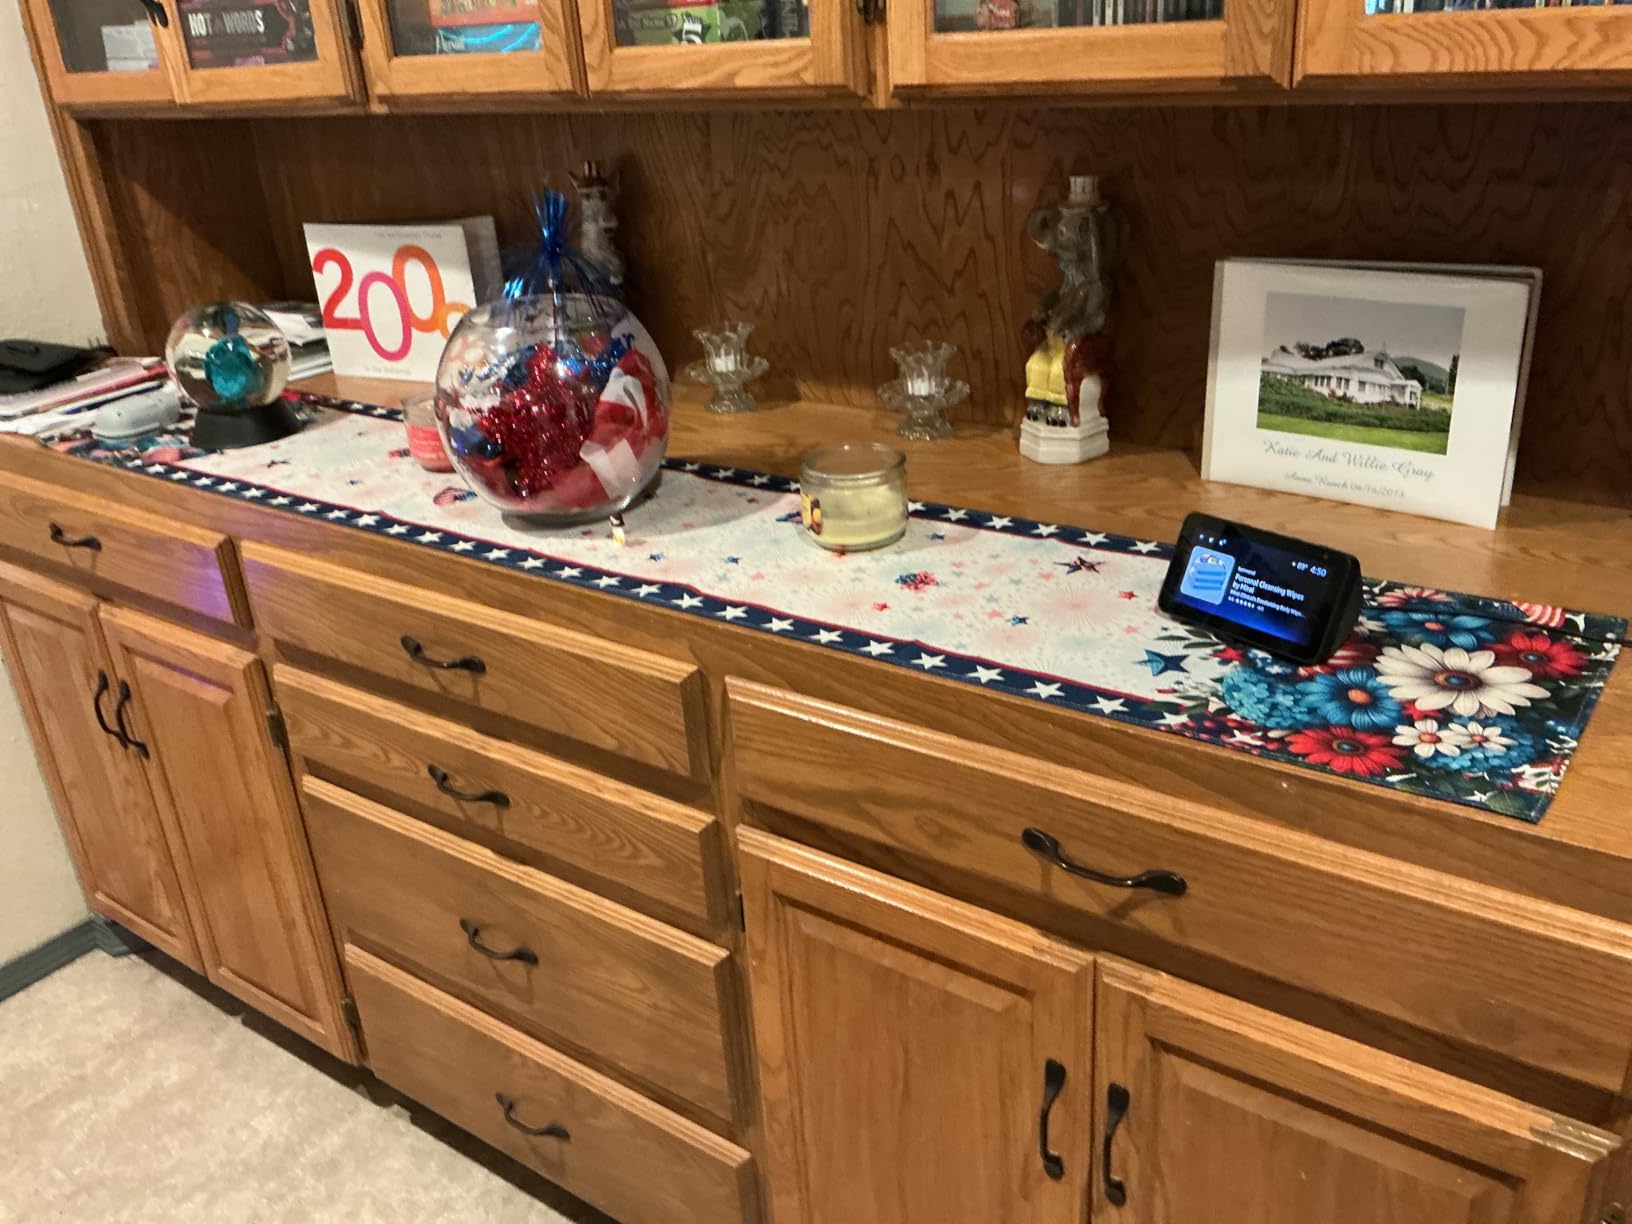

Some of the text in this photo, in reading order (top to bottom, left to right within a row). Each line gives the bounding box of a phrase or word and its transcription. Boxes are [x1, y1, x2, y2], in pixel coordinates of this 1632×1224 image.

[222, 9, 265, 34] WORDS
[1263, 439, 1435, 482] Katie And Willie Gray
[1310, 564, 1327, 577] 4:50
[1234, 573, 1260, 588] Personal
[1259, 580, 1286, 597] Cleansing
[1286, 587, 1305, 602] Wipes
